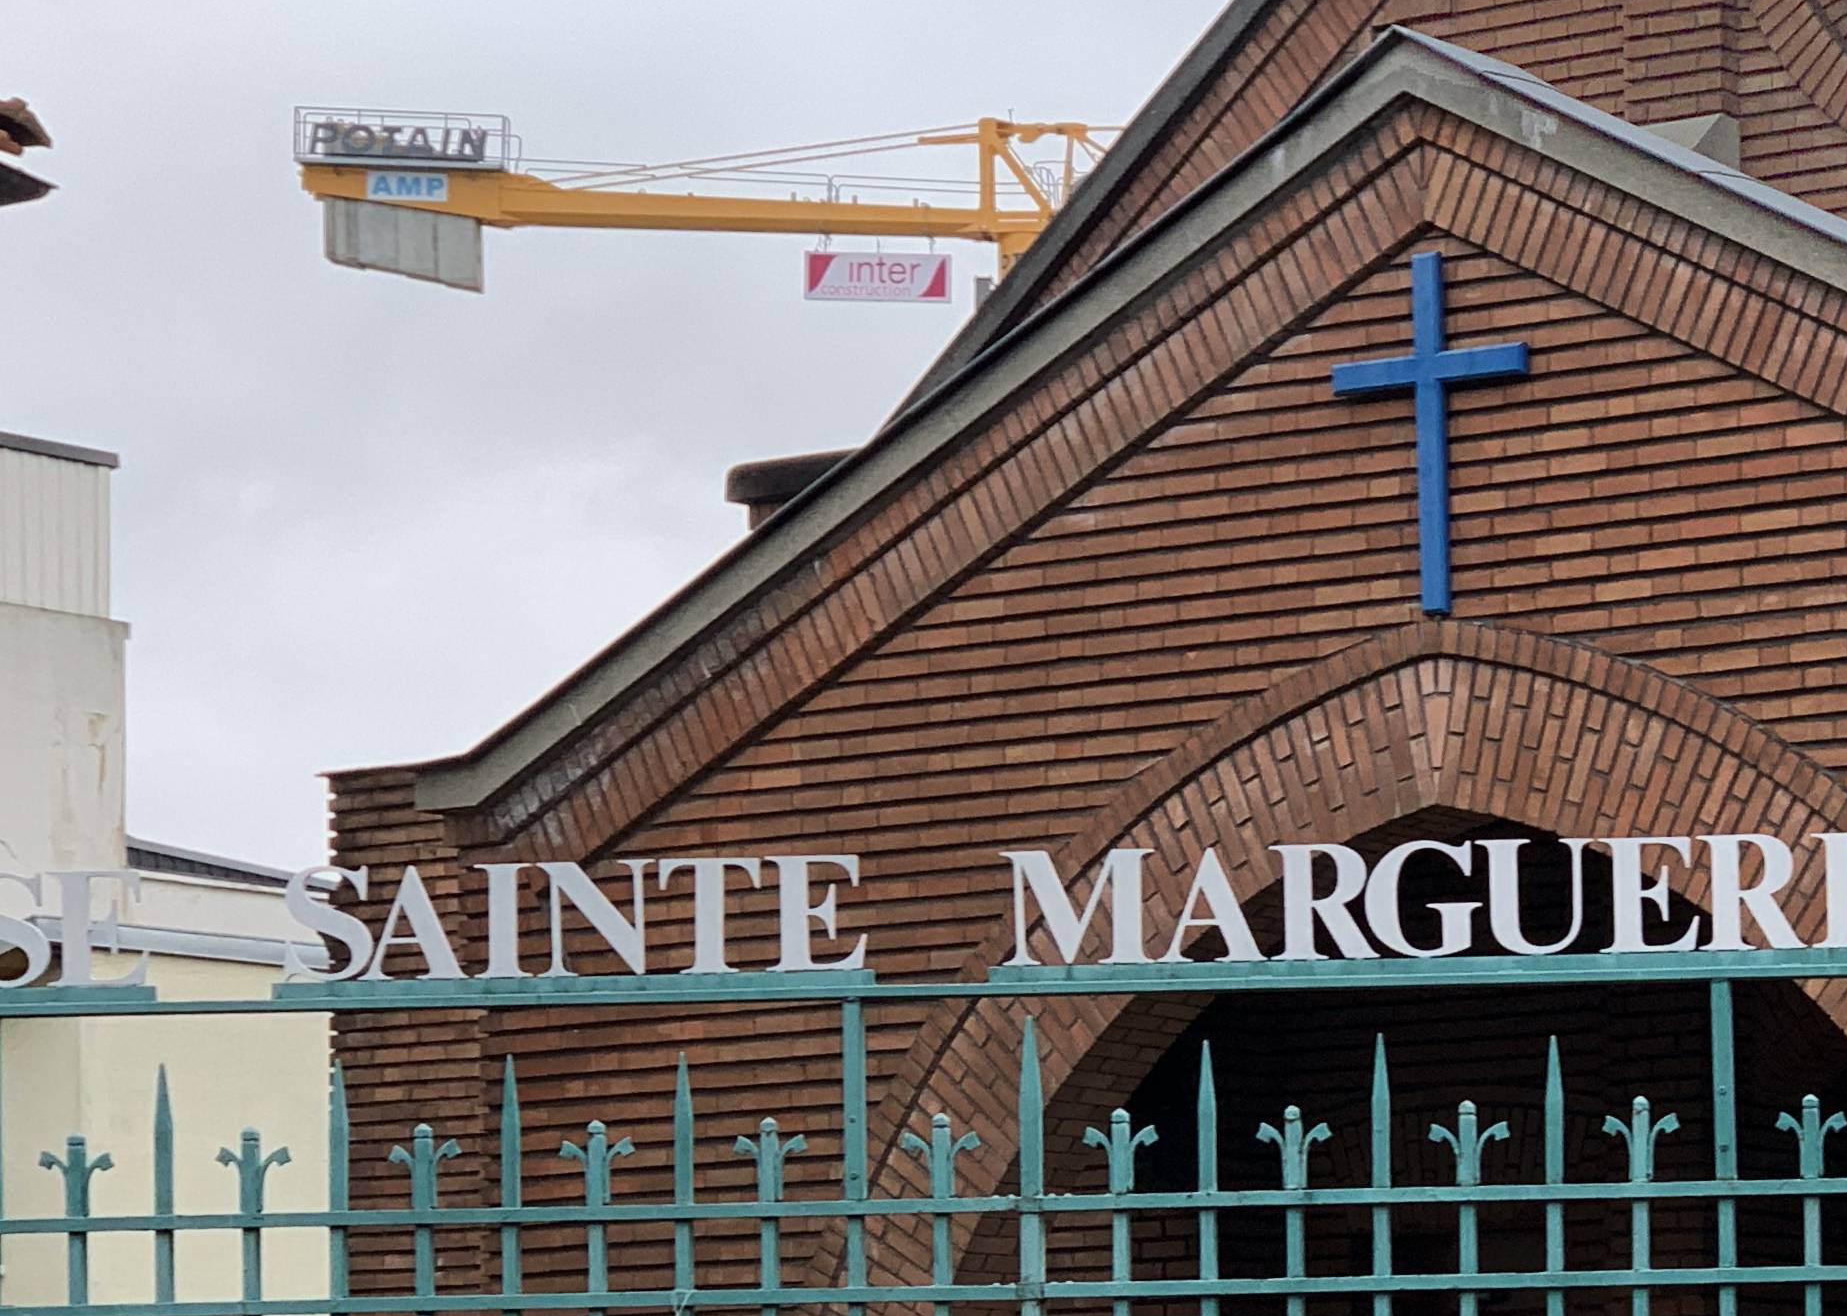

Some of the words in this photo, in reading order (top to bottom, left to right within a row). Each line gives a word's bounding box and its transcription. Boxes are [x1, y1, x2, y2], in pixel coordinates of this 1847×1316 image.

[307, 122, 488, 162] POTAIN
[370, 174, 445, 197] AMP
[848, 256, 923, 285] inter
[820, 284, 912, 298] construction
[283, 853, 867, 982] SAINTE
